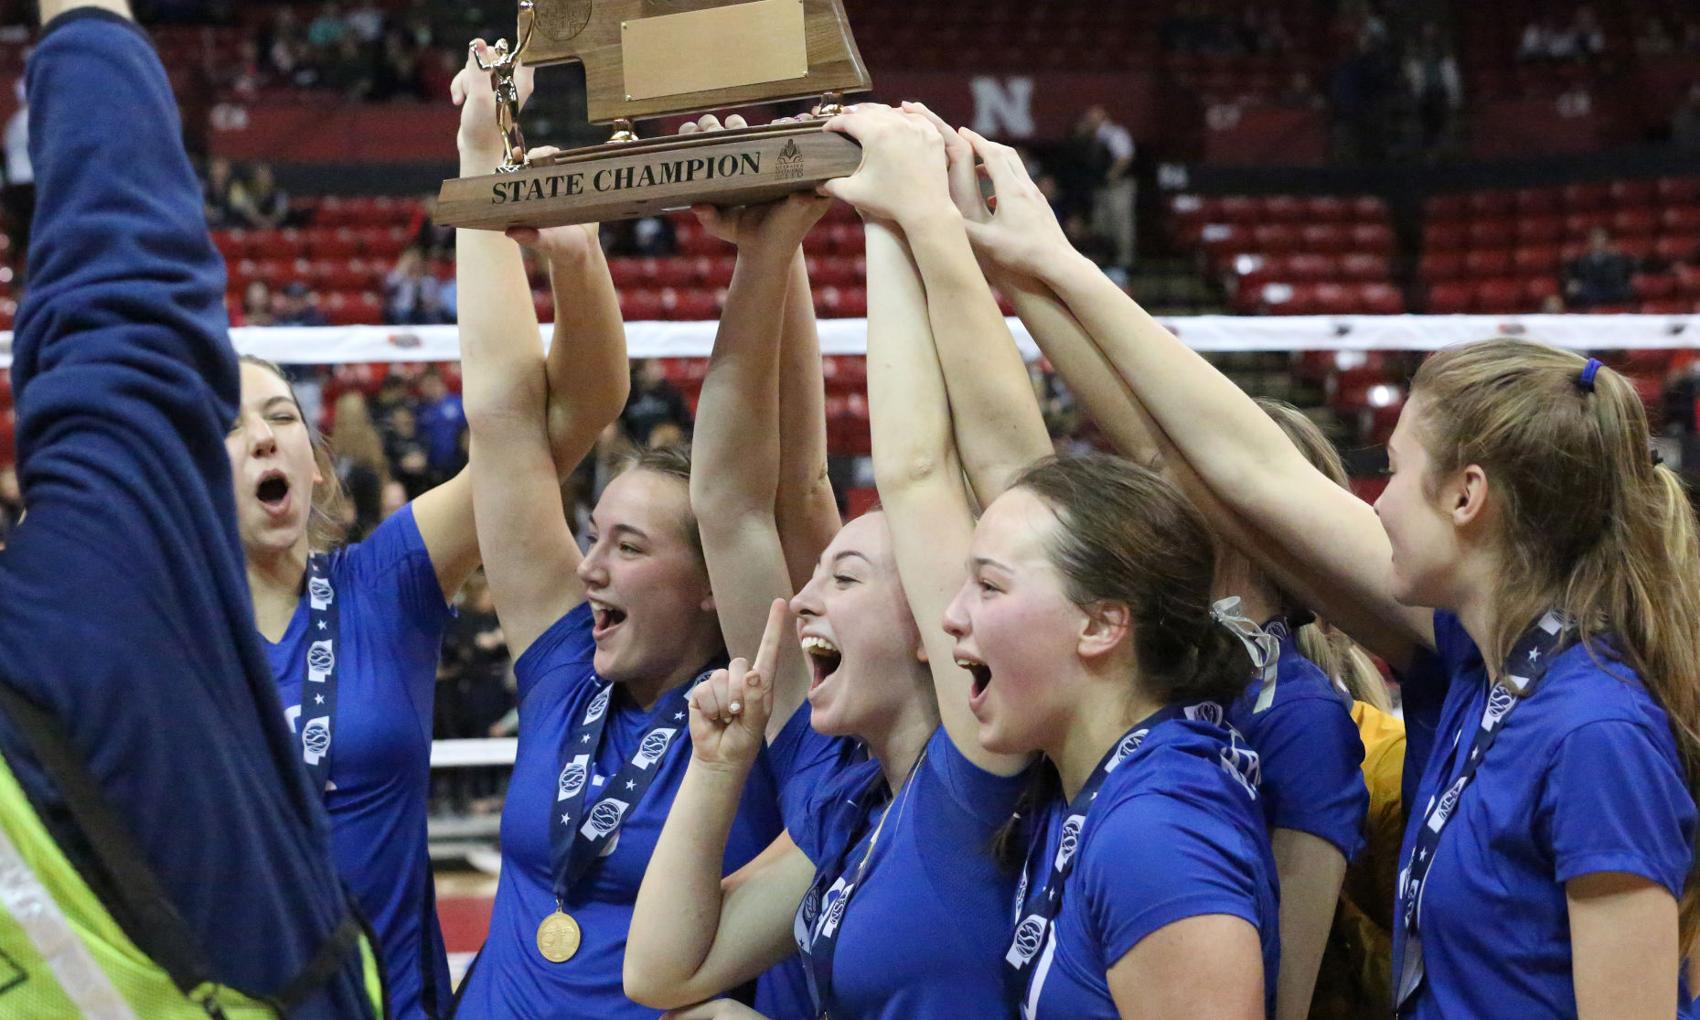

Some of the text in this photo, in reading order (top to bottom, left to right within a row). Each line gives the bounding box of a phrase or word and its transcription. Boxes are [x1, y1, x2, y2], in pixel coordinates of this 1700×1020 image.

[971, 76, 1034, 137] N
[491, 173, 585, 206] STATE
[593, 151, 761, 193] CHAMPION
